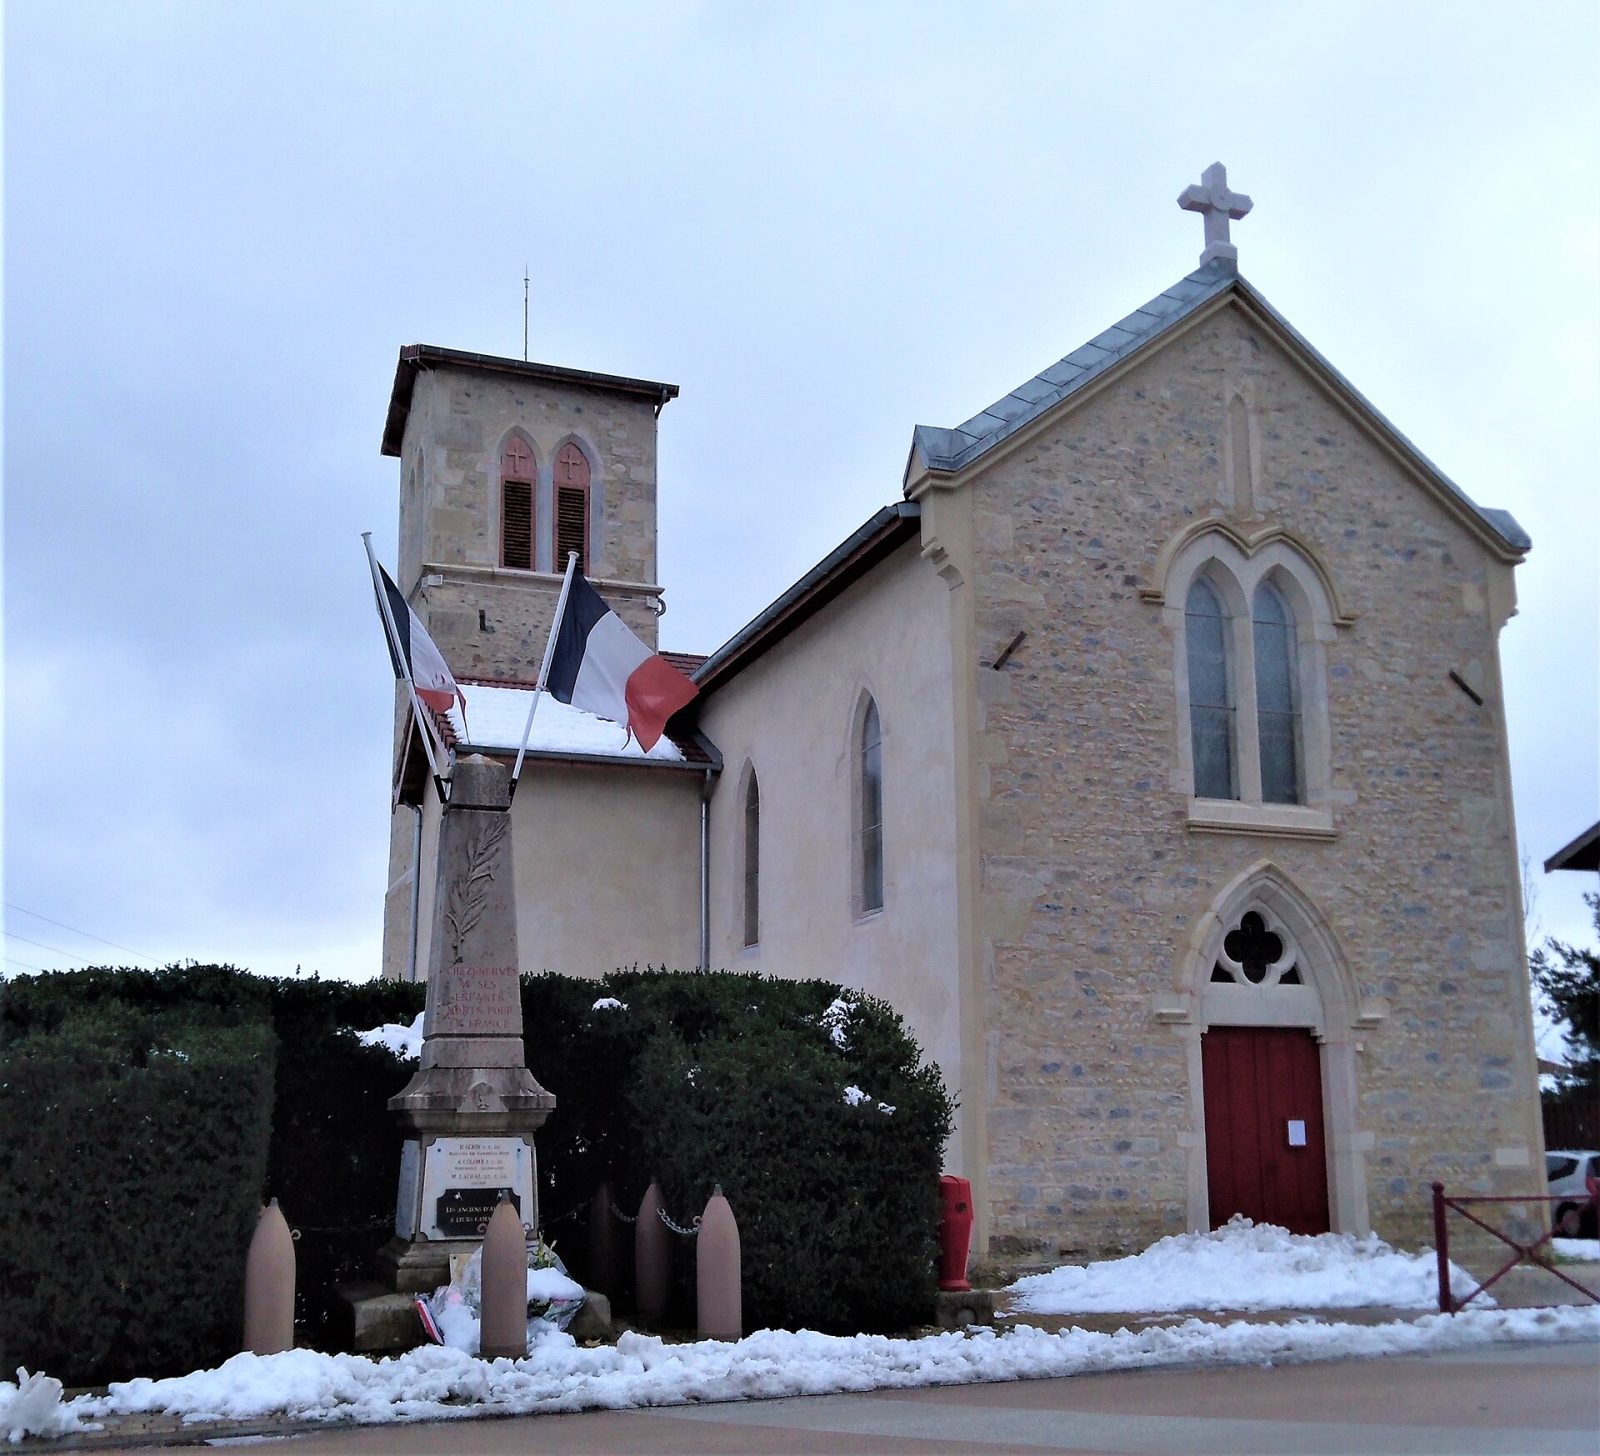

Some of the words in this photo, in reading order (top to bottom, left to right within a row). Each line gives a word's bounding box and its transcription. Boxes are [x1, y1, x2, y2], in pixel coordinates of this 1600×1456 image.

[478, 980, 497, 989] SES
[455, 992, 504, 1002] ENFANTS
[448, 1006, 482, 1015] MORTS
[487, 1006, 513, 1015] POUR
[469, 1019, 511, 1028] FRANCE
